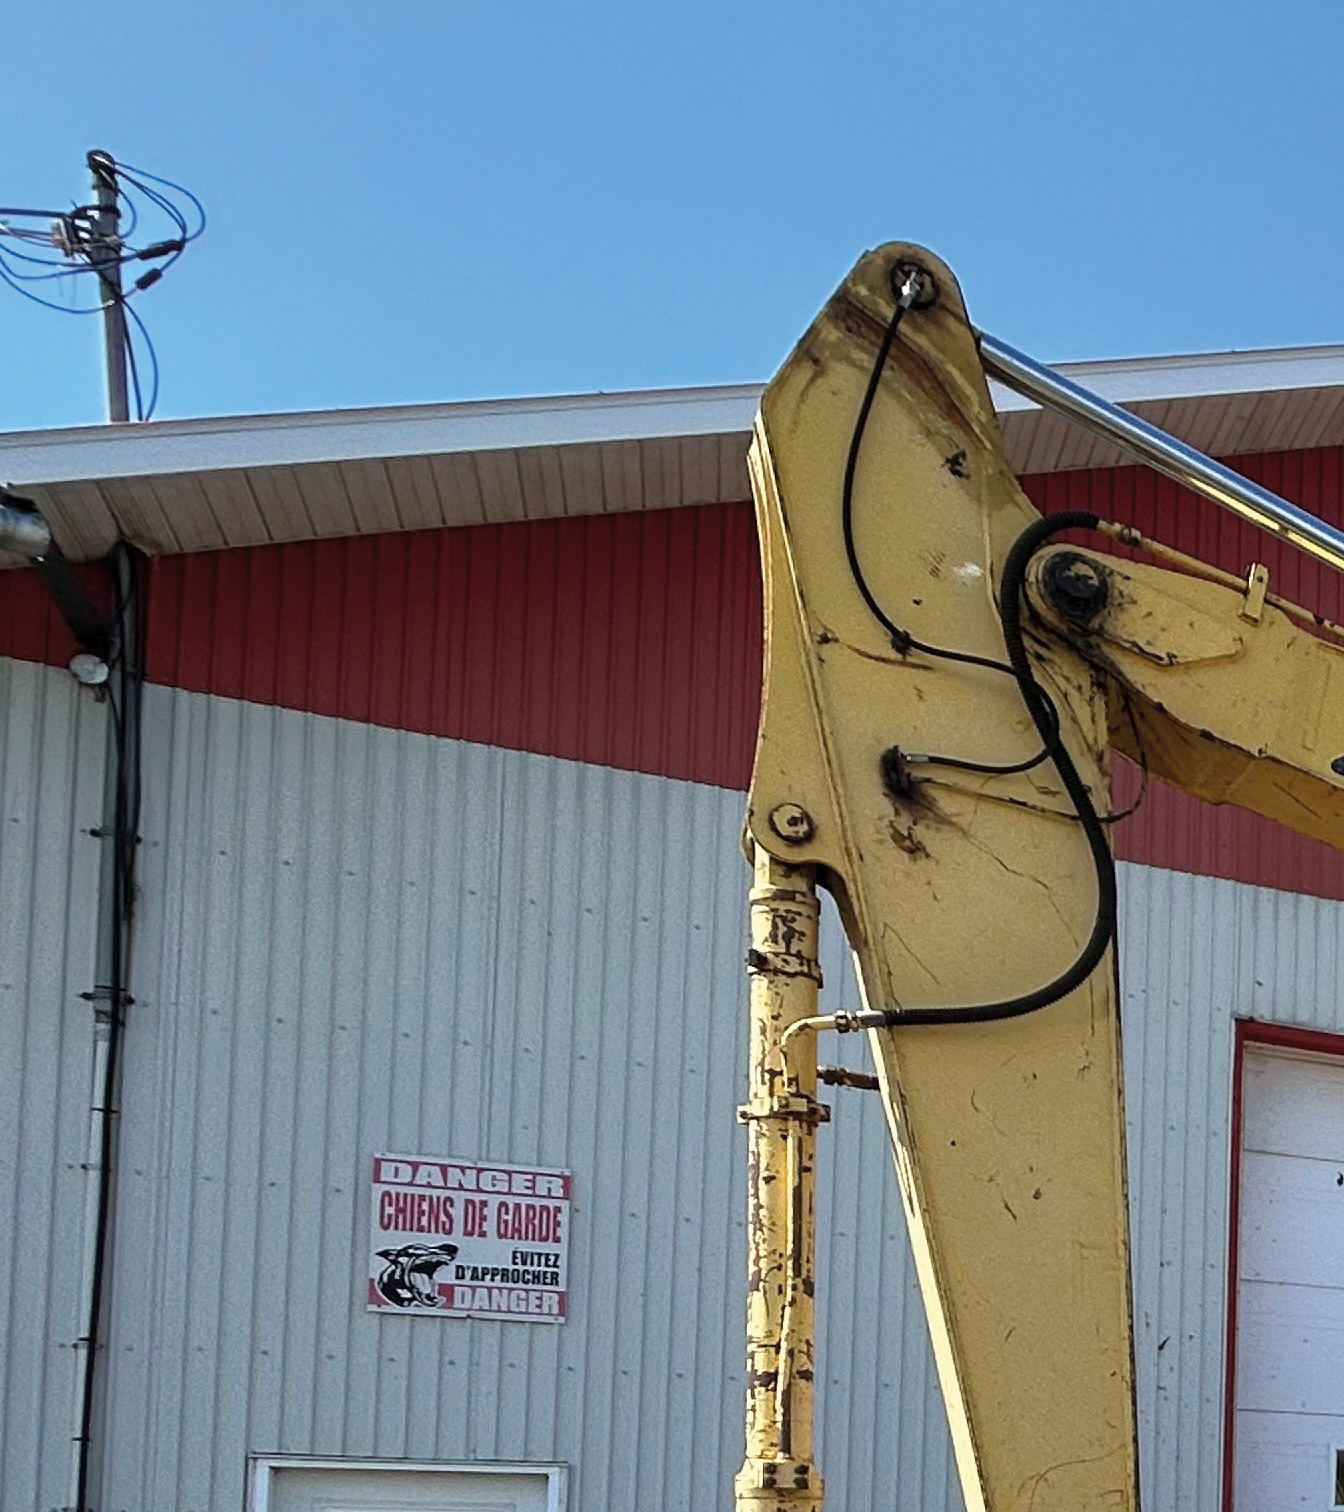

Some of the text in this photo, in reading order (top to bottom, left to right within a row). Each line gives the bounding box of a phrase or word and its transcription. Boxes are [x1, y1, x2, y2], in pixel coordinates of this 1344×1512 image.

[379, 1161, 565, 1197] DANGER
[379, 1190, 561, 1243] CHIENS DE GARDE
[455, 1265, 559, 1286] D'APPROCHER
[453, 1286, 560, 1314] DANGER
